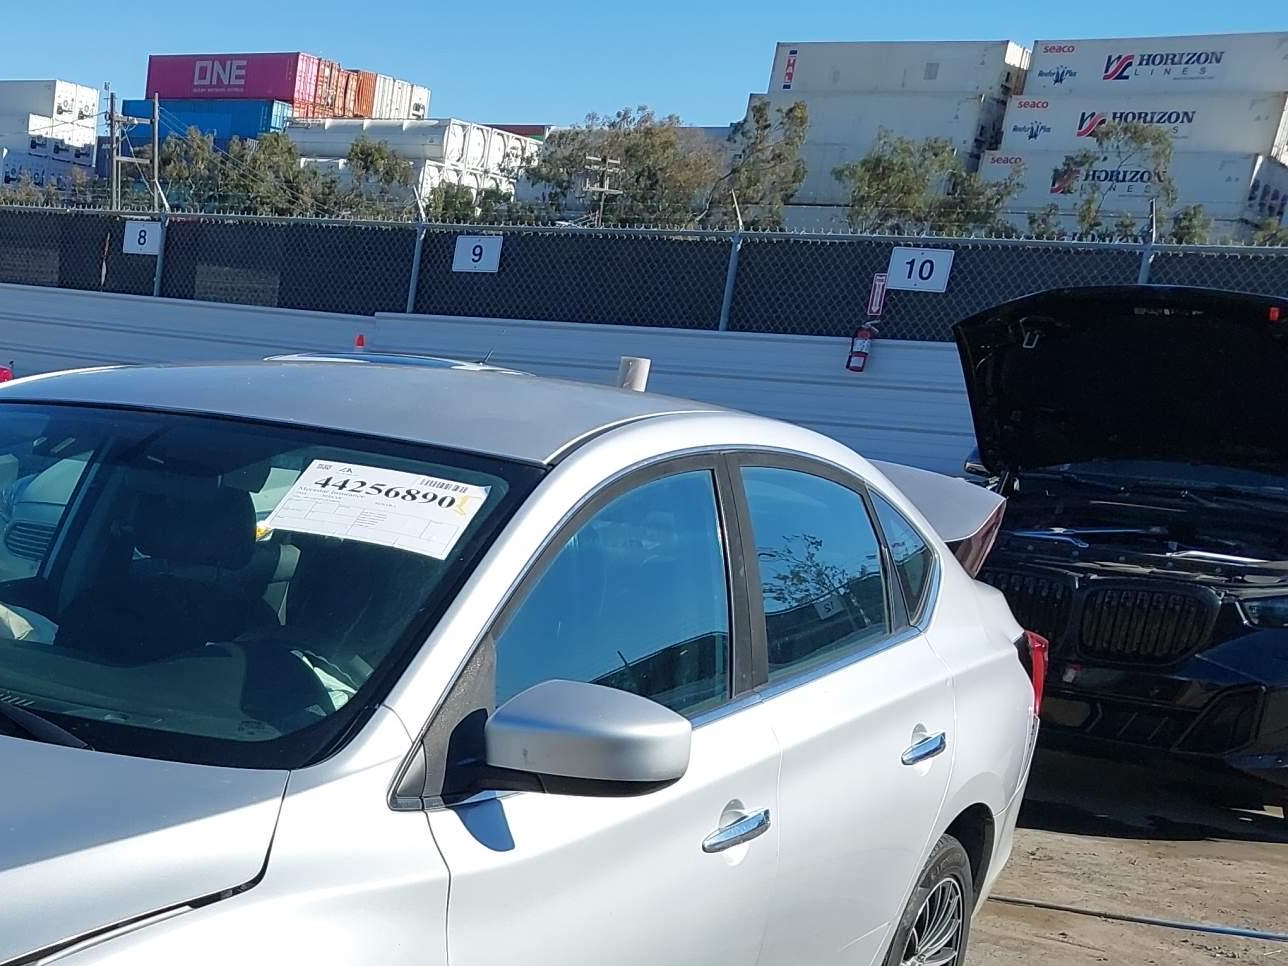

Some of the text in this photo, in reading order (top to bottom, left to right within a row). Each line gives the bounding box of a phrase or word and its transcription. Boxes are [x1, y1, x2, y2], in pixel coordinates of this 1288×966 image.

[1042, 45, 1075, 54] seaco
[1137, 51, 1225, 66] HORIZON
[193, 60, 248, 85] ONE
[1134, 67, 1207, 76] LINES
[1016, 100, 1049, 109] seaco
[1112, 111, 1197, 124] HORIZON
[991, 156, 1022, 164] seaco
[137, 229, 147, 246] 8
[471, 244, 483, 263] 9
[905, 258, 935, 281] 10
[314, 476, 456, 509] 44256890
